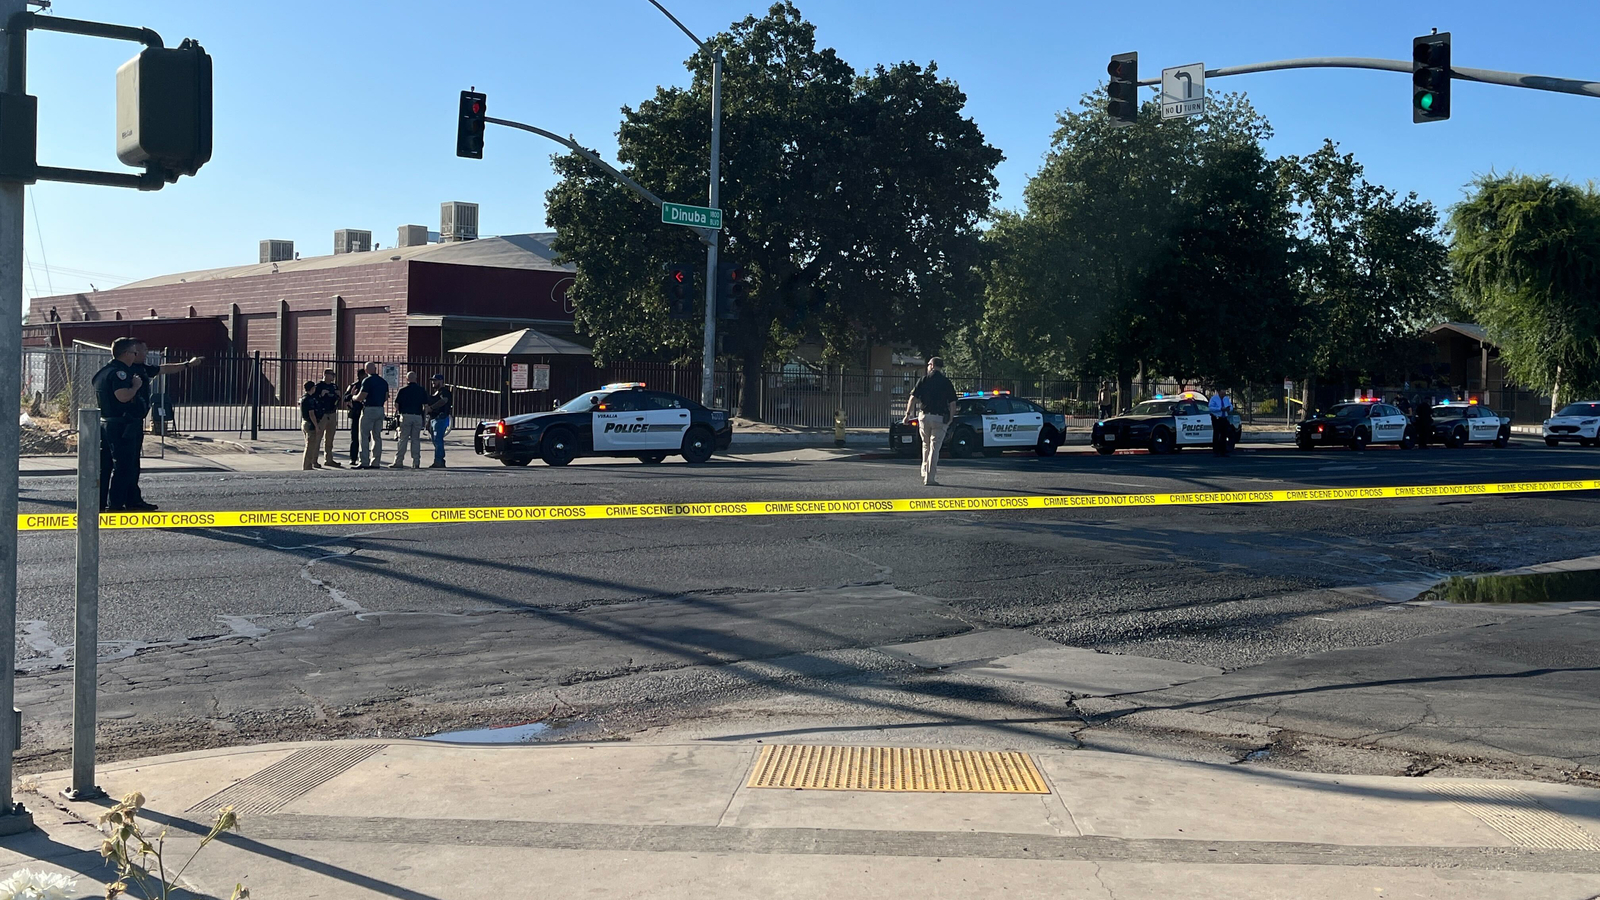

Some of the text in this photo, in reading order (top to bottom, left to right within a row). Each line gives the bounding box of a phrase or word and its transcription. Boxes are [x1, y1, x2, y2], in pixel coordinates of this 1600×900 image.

[1166, 103, 1201, 114] NO U TURN
[671, 207, 706, 223] Dinuba
[604, 422, 650, 433] POLICE
[990, 423, 1018, 433] POLICE
[1181, 423, 1205, 432] POLICE
[1395, 485, 1486, 496] CRIME SCENE DO NOT CROSS
[1498, 484, 1517, 492] CRIME
[1518, 483, 1538, 492] SCENE
[1539, 482, 1549, 491] DO
[1549, 482, 1561, 490] NOT
[1563, 481, 1583, 490] CROSS
[1170, 492, 1274, 503] CRIME SCENE DO NOT CROSS
[1287, 488, 1383, 500] CRIME SCENE DO NOT CROSS
[910, 497, 1029, 509] CRIME SCENE DO NOT CROSS
[1044, 495, 1156, 506] CRIME SCENE DO NOT CROSS
[606, 504, 748, 516] CRIME SCENE DO NOT CROSS
[765, 500, 894, 513] CRIME SCENE DO NOT CROSS
[240, 510, 410, 524] CRIME SCENE DO NOT CROSS
[431, 507, 586, 520] CRIME SCENE DO NOT CROSS
[27, 516, 70, 527] CRIME
[121, 515, 139, 526] DO
[142, 514, 169, 526] NOT
[172, 514, 215, 525] CROSS
